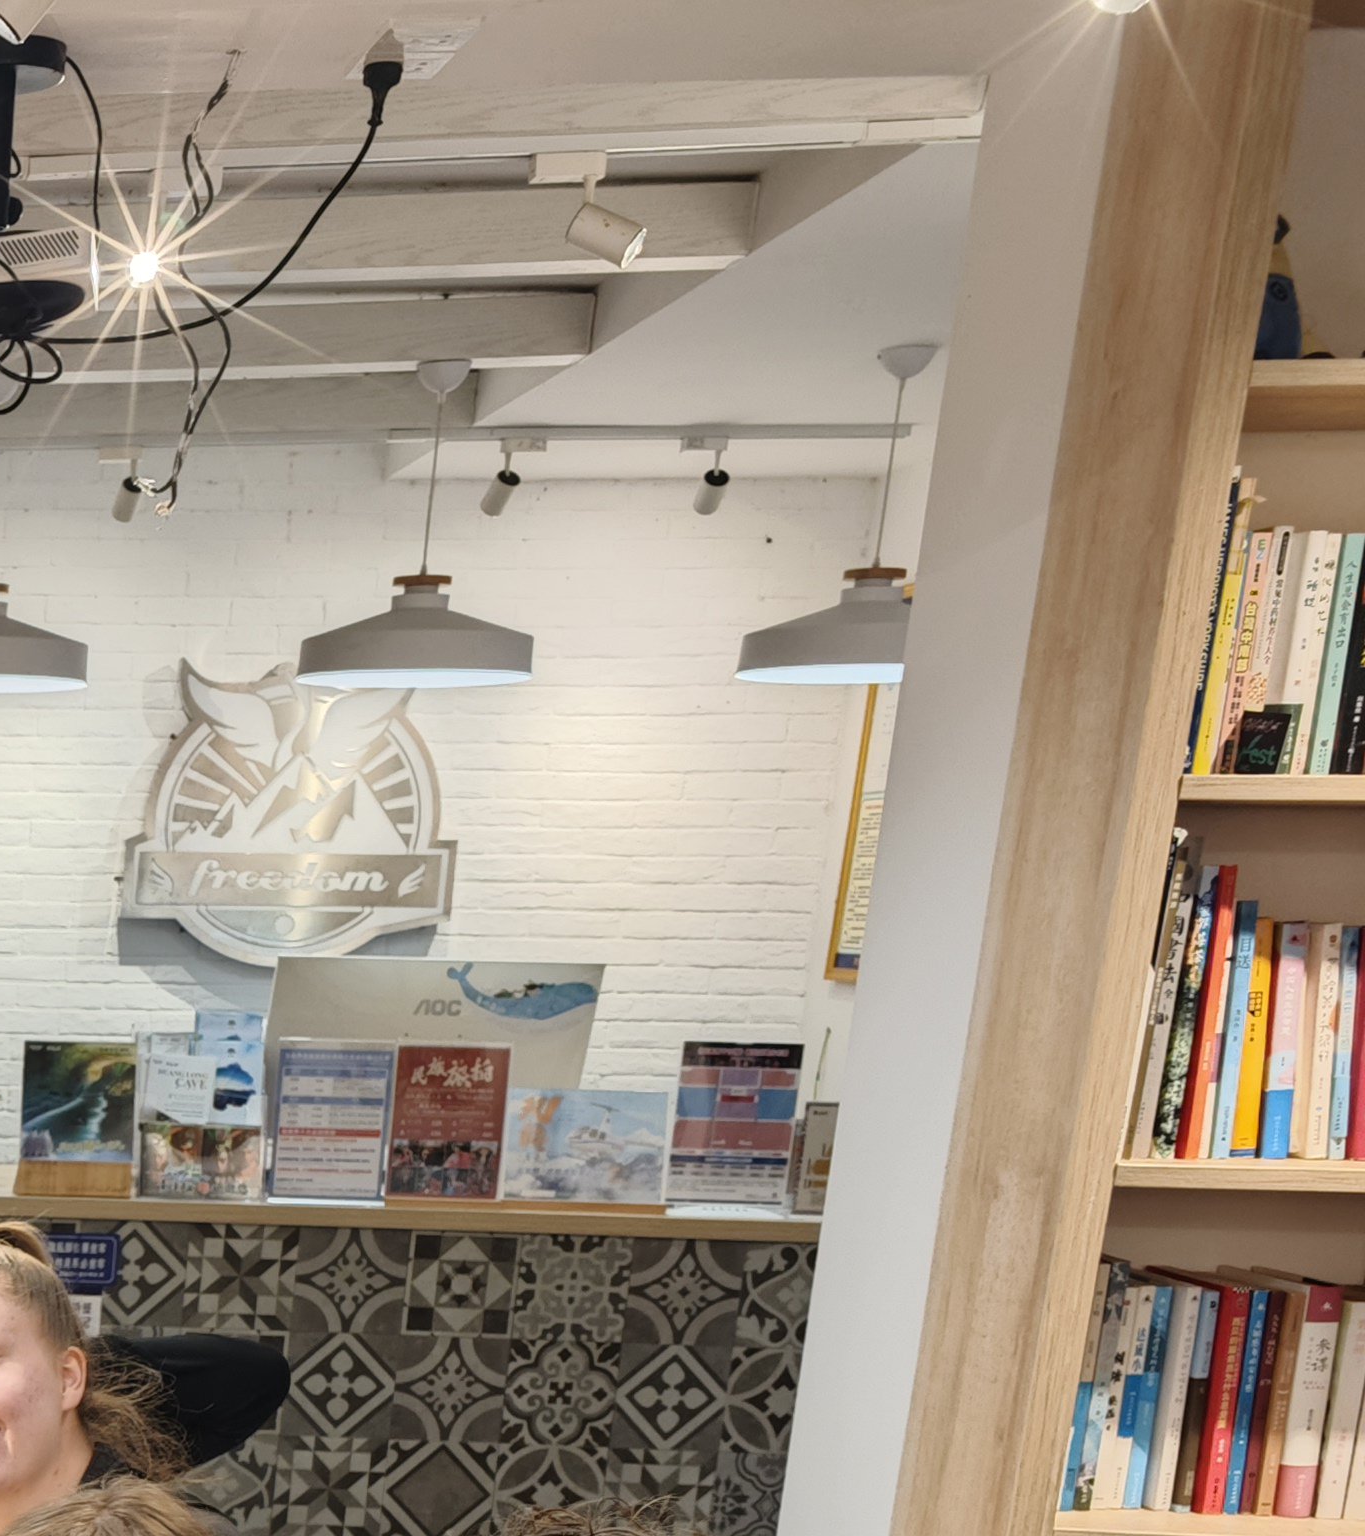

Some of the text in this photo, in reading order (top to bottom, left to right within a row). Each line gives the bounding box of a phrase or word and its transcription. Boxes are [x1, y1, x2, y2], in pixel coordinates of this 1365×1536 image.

[186, 859, 389, 897] freedom
[413, 999, 462, 1017] AOC
[175, 1077, 207, 1091] CAVE
[411, 1056, 495, 1088] 民族旅拍
